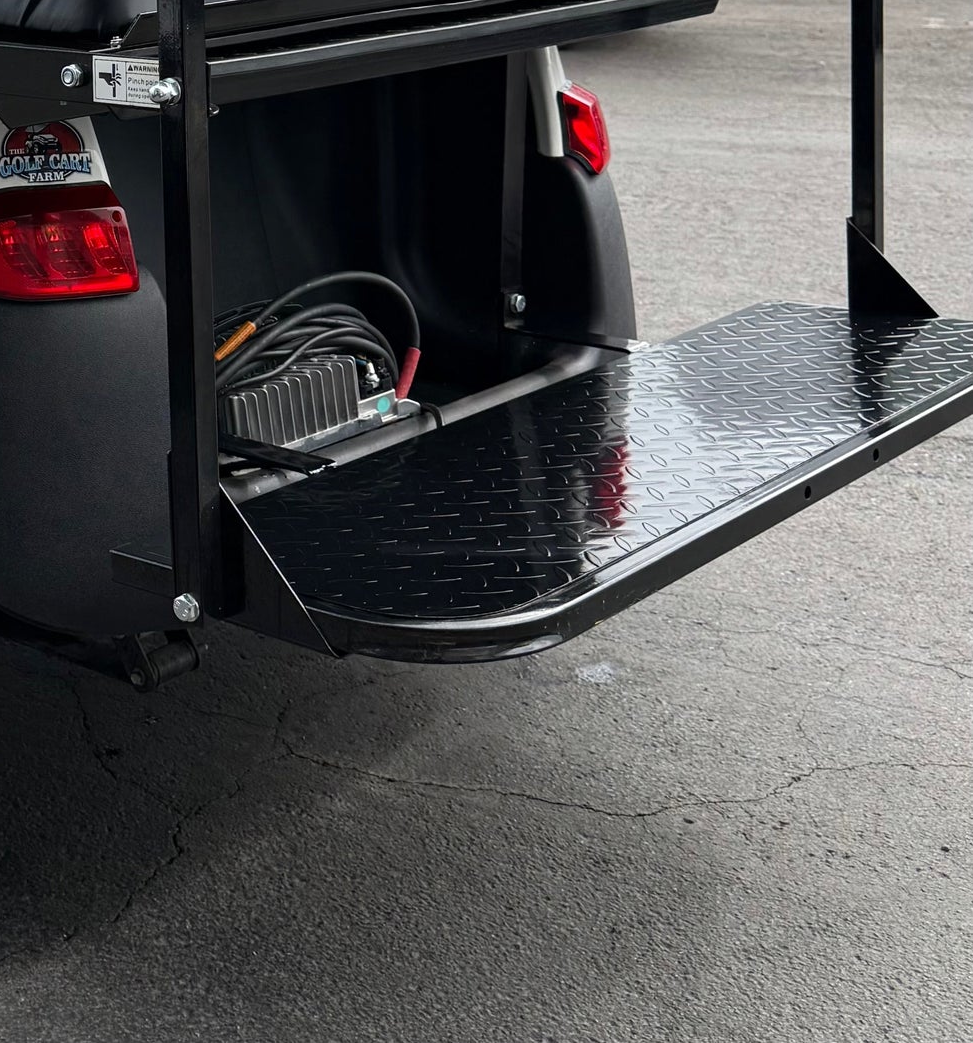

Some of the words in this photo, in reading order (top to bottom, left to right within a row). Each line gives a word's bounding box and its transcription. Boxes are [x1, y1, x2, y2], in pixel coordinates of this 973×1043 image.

[128, 77, 145, 85] Pinch
[0, 154, 45, 178] GOLF
[48, 152, 91, 173] CART
[29, 171, 65, 182] FARM
